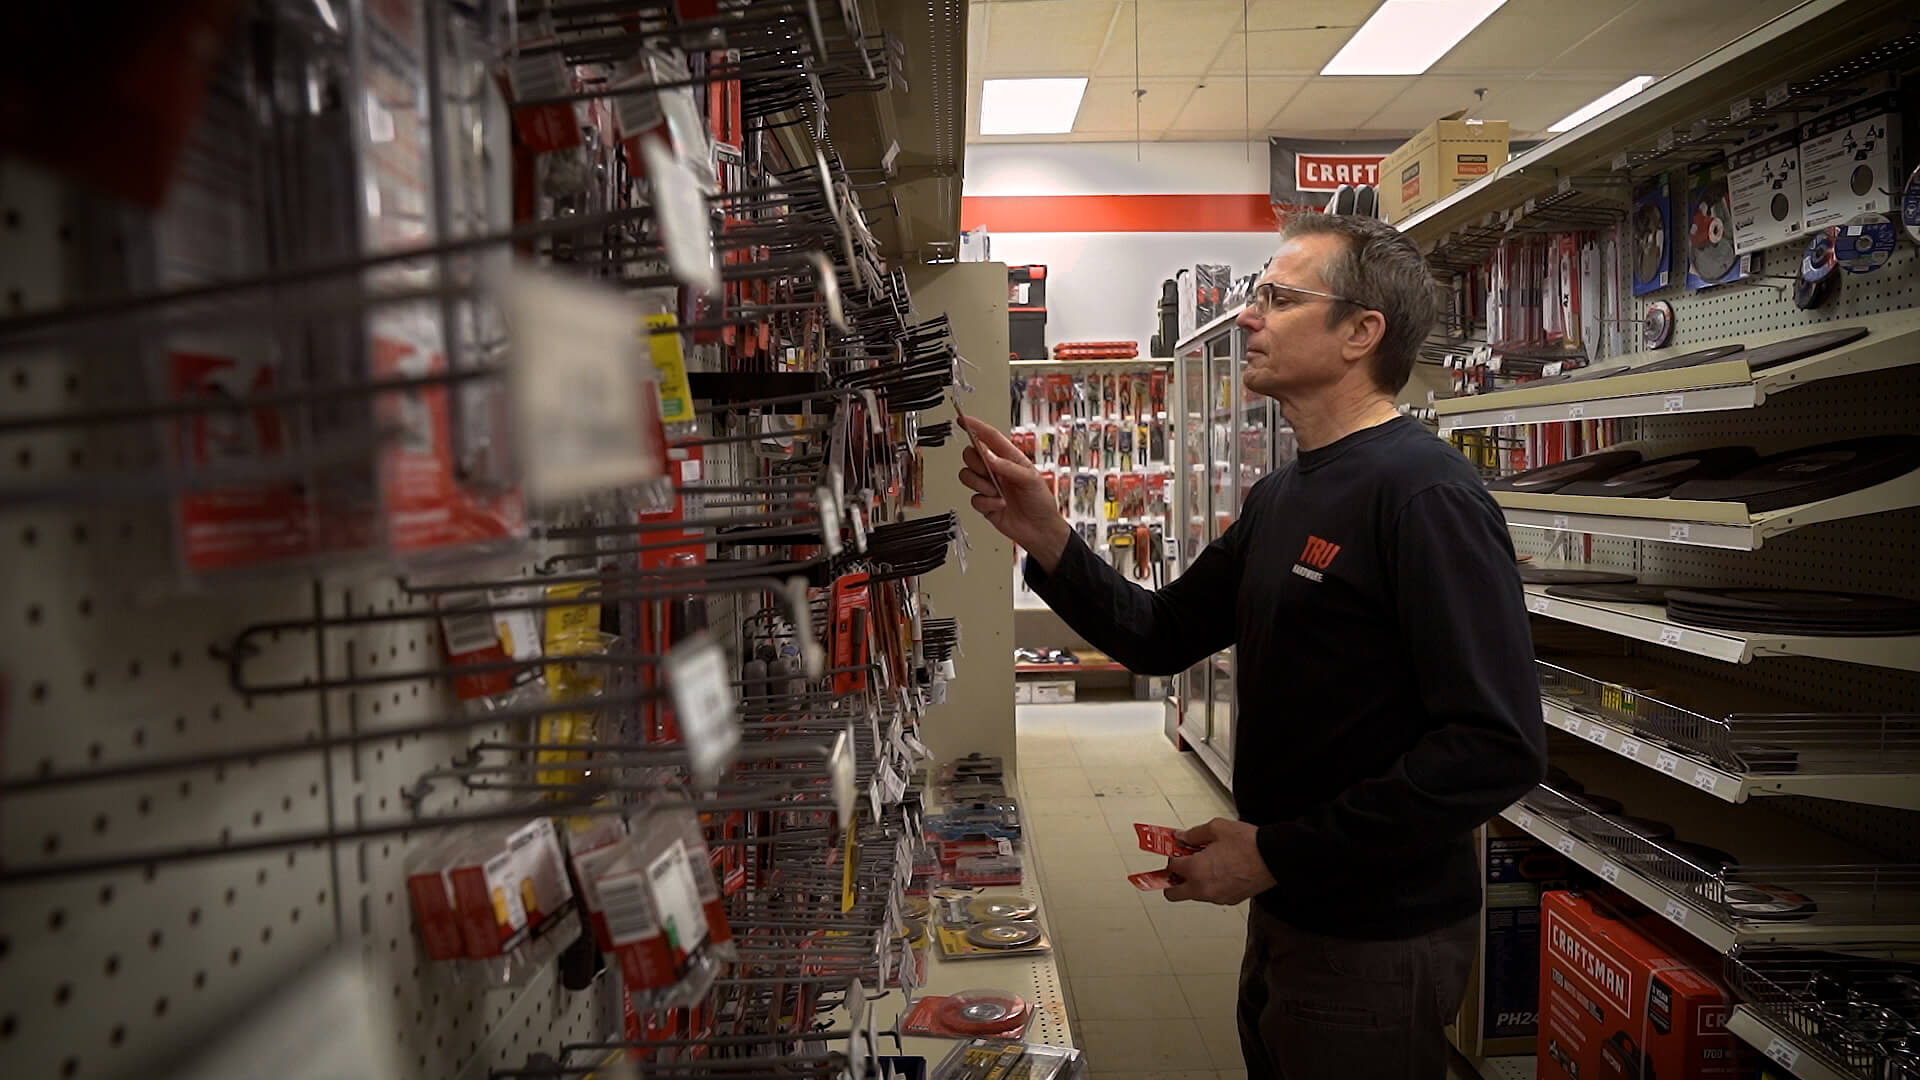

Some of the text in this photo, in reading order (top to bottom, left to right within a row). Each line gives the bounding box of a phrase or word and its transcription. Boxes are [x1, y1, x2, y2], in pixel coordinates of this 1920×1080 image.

[1306, 162, 1378, 184] CRAFT
[1300, 535, 1341, 569] TRU
[1552, 925, 1625, 1001] CRAFTSMAN
